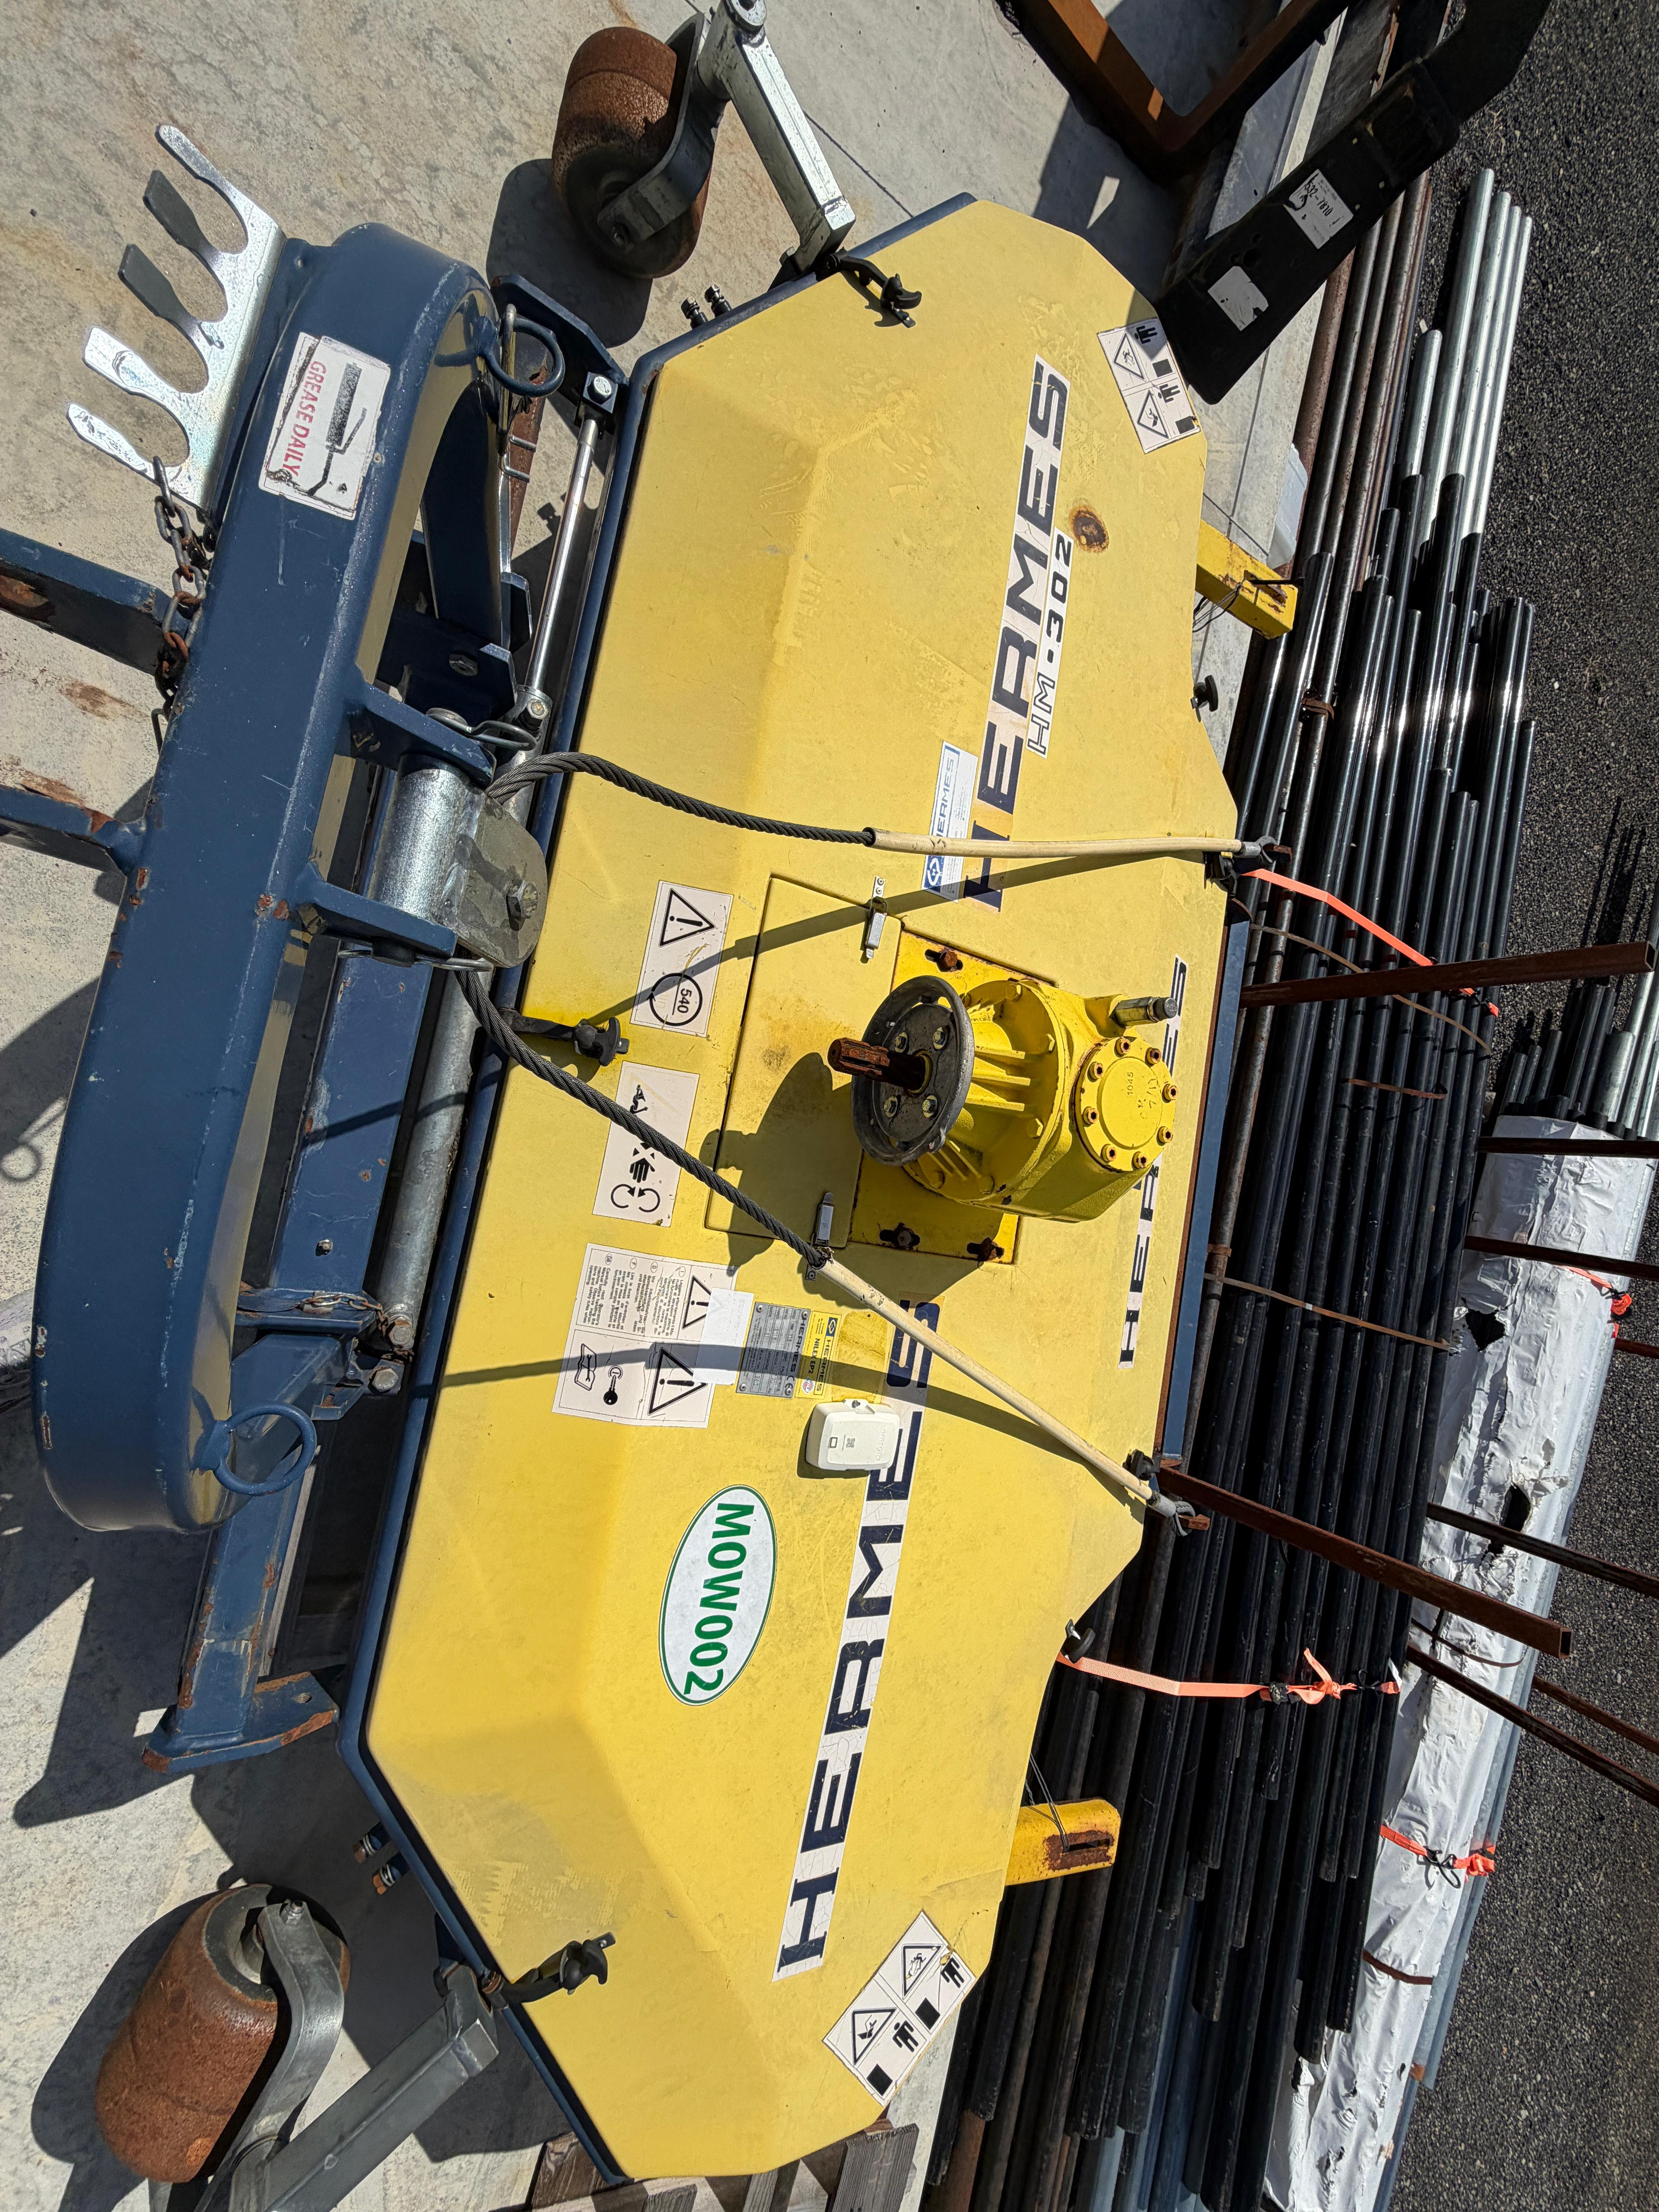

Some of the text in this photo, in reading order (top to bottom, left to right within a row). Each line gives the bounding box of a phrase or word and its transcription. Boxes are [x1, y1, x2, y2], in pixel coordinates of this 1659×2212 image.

[282, 361, 326, 477] GREASE DAILY
[964, 360, 1068, 912] HERMES
[1027, 533, 1071, 755] HM-302
[935, 756, 954, 838] ERMES
[677, 988, 692, 1014] 540
[585, 1265, 594, 1286] operating.
[811, 1338, 820, 1359] NILEX
[816, 1339, 830, 1391] HERMES
[684, 1503, 754, 1695] MOW002
[778, 1300, 940, 1973] HERMES
